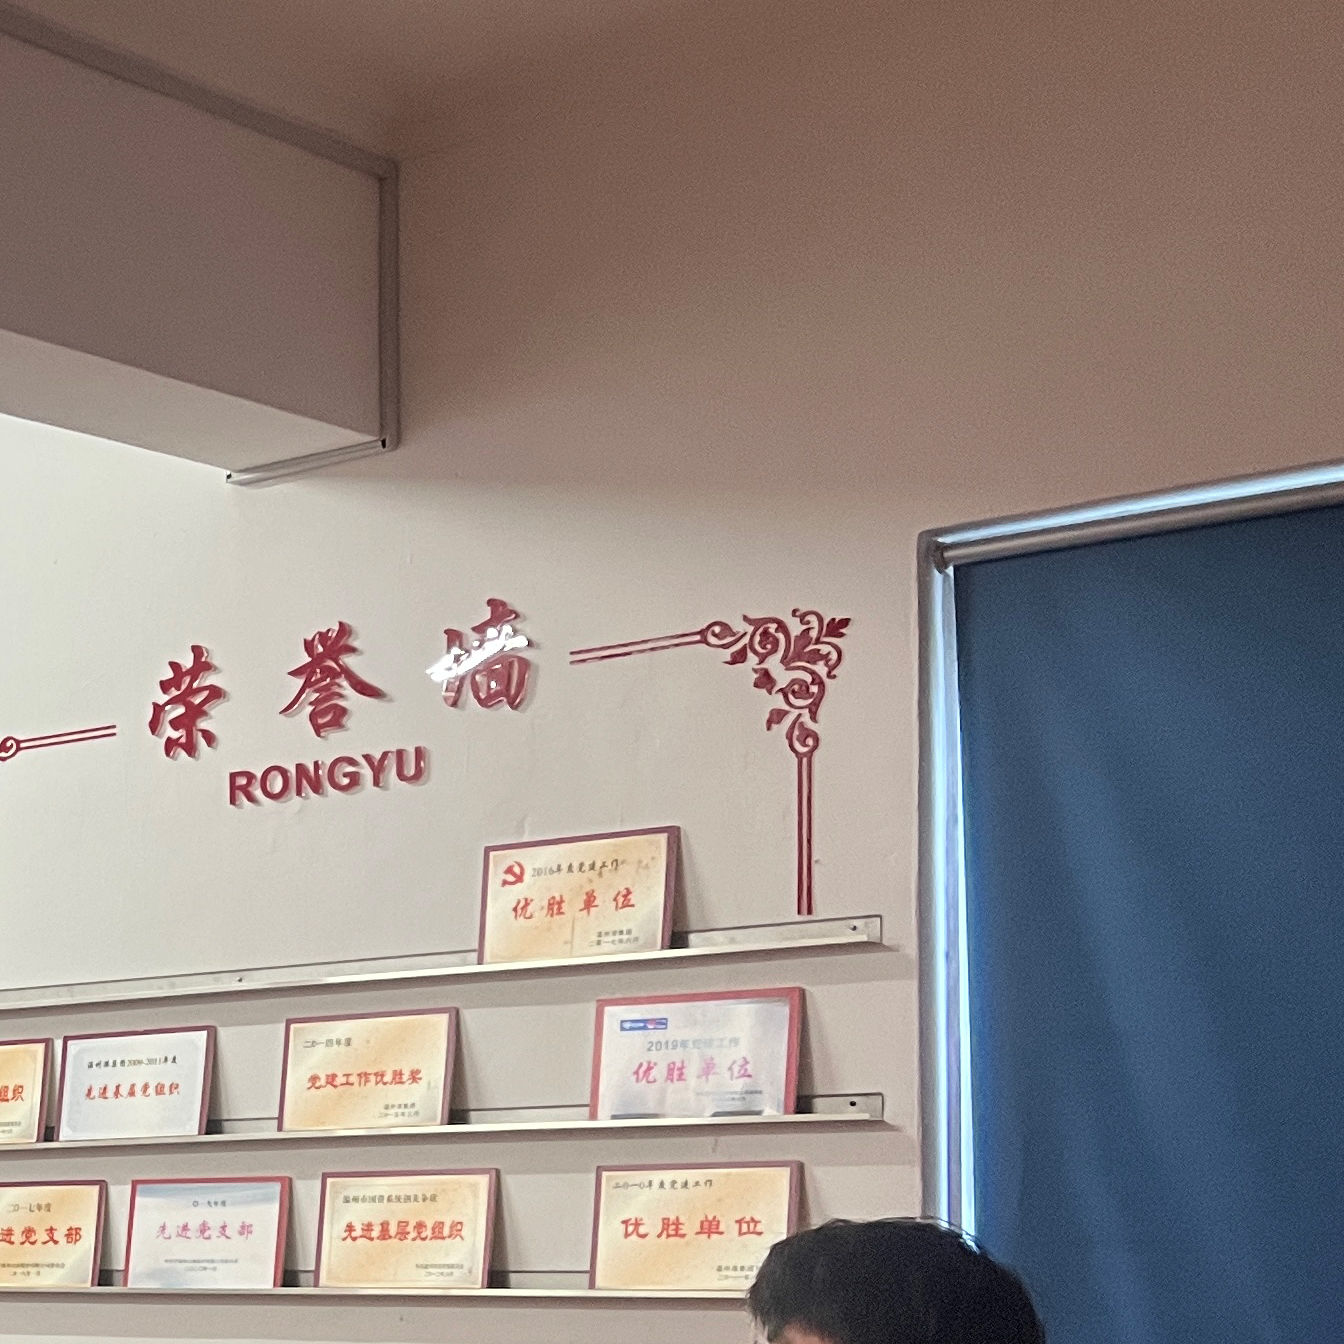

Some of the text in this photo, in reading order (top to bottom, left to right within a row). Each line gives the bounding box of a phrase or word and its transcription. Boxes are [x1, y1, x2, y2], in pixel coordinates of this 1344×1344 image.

[148, 598, 531, 760] 荣誉墙
[229, 745, 428, 807] RONGYU
[512, 886, 636, 921] 优胜单位
[306, 1068, 424, 1091] 党建工作优胜奖
[633, 1056, 754, 1085] 优胜单位
[85, 1081, 181, 1101] 先进基层党组织
[156, 1219, 254, 1241] 先进党支部
[341, 1219, 465, 1242] 先进基层党组织
[621, 1213, 765, 1240] 优胜单位
